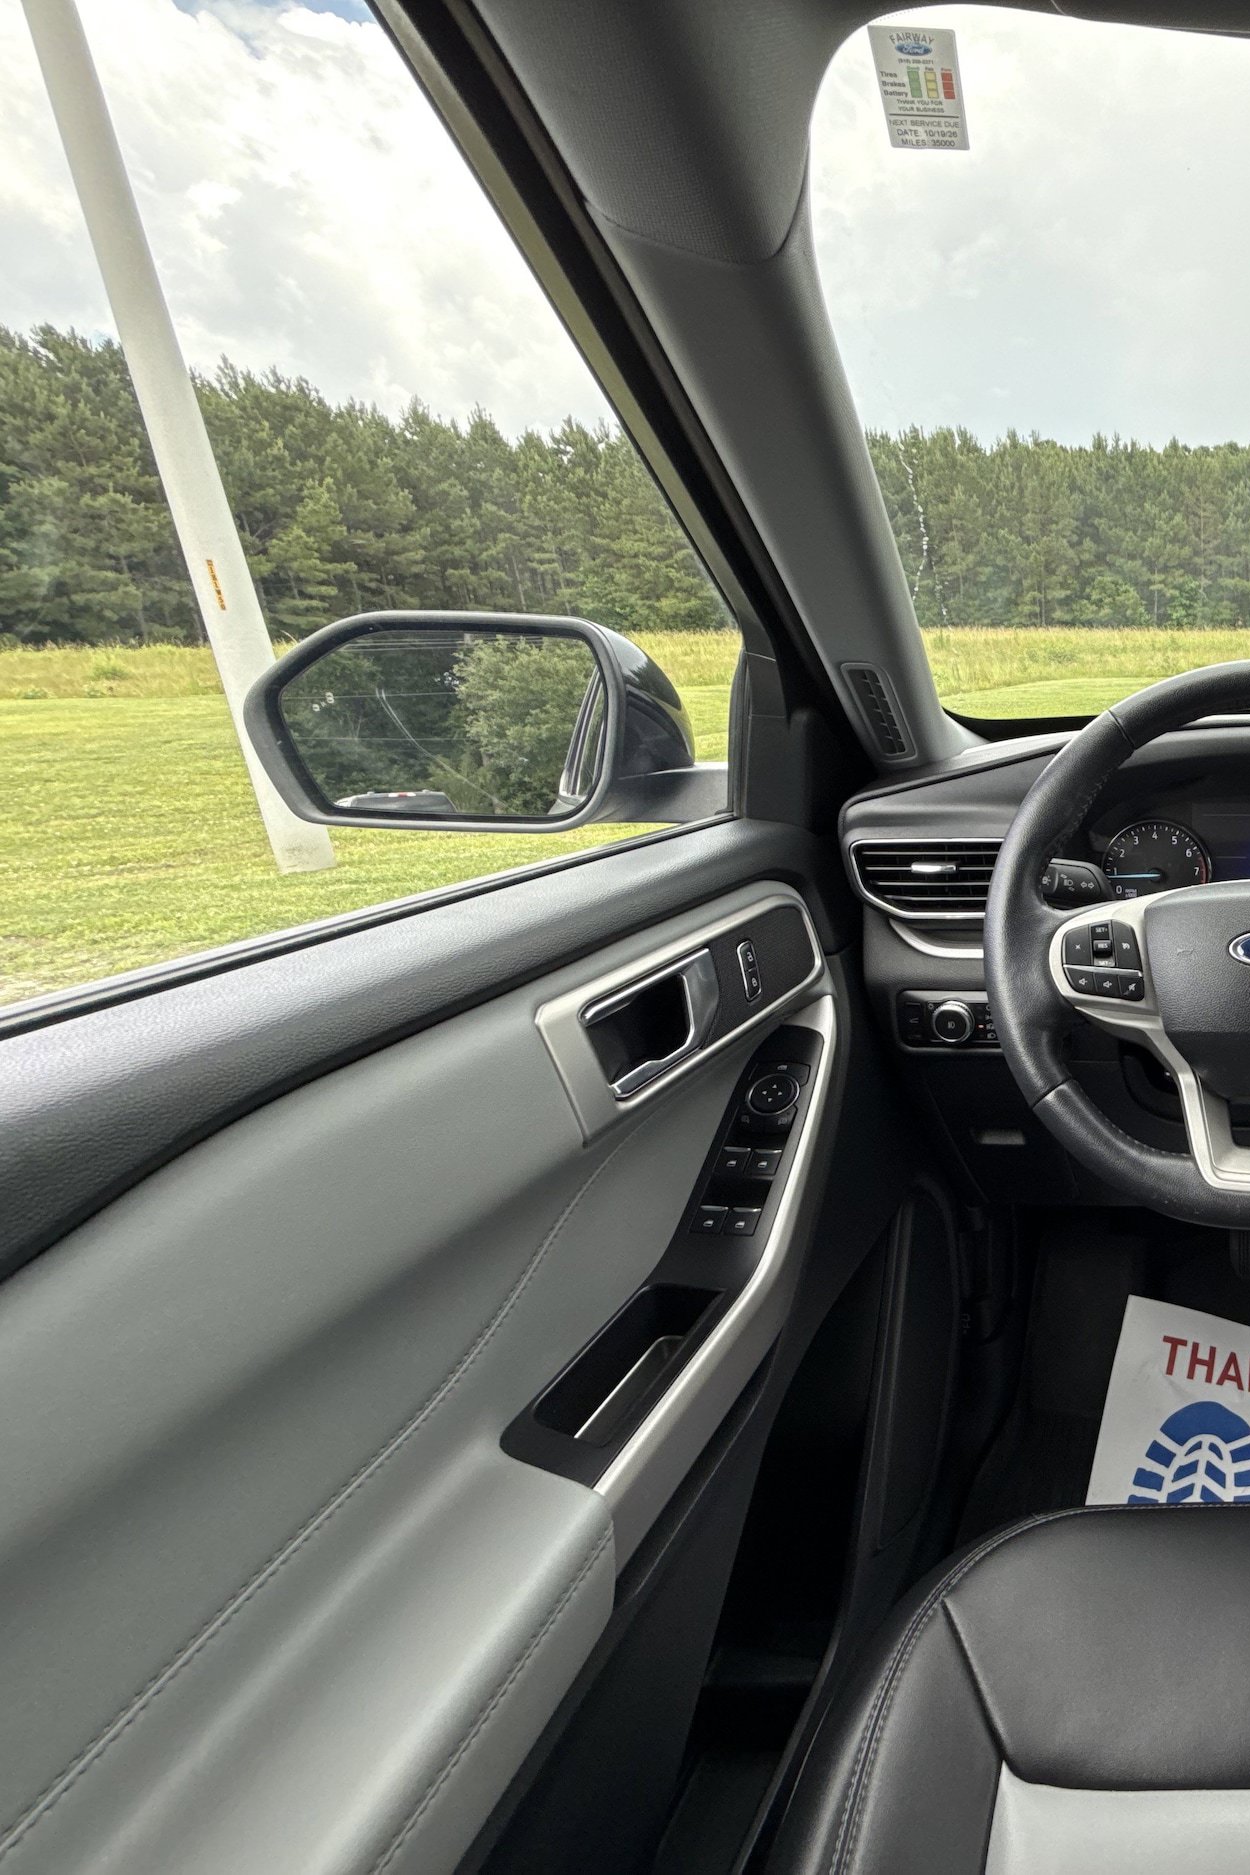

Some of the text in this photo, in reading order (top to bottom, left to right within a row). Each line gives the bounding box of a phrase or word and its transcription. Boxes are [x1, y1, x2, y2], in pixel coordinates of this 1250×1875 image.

[889, 32, 935, 45] FAIRWAY
[902, 42, 925, 55] Ford
[883, 90, 909, 98] Battery
[910, 120, 943, 128] SERVICE
[944, 120, 960, 128] DUE
[1152, 831, 1158, 840] 4
[1133, 836, 1139, 845] 3
[1171, 836, 1178, 845] 5
[1119, 849, 1125, 858] 2
[1185, 848, 1192, 857] 6
[1113, 867, 1118, 876] 1
[1194, 866, 1200, 876] 7
[1115, 885, 1122, 895] 0
